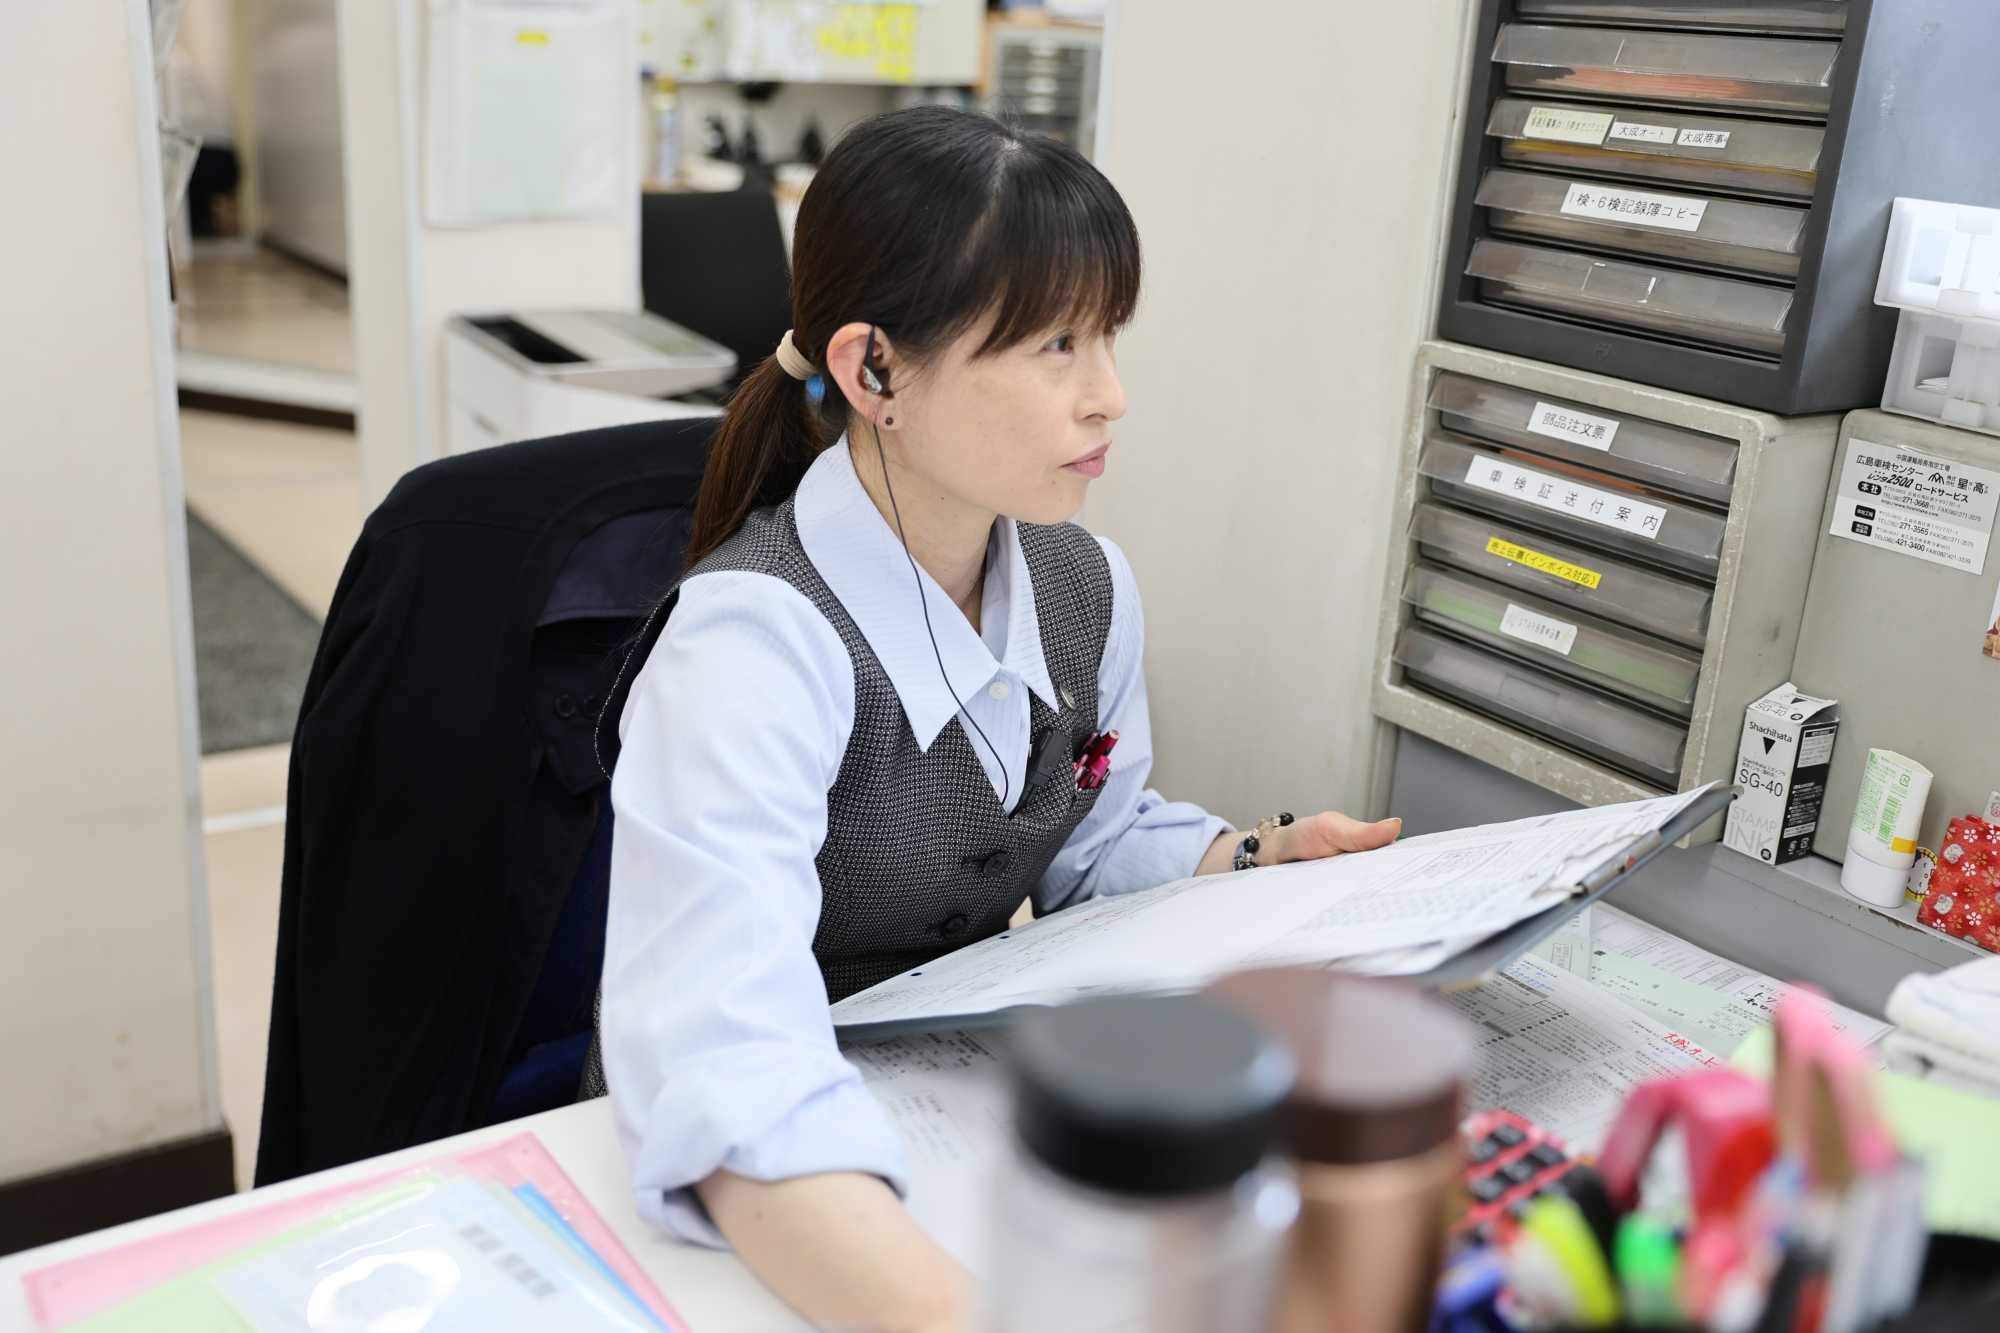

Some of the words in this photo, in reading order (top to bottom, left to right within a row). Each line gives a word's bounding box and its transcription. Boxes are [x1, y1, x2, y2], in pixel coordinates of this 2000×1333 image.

[1543, 411, 1607, 441] 部品注文票
[1856, 454, 1924, 477] 広島車検センター
[1914, 482, 1969, 504] ロードサービス
[1748, 720, 1793, 744] Shachihata
[1738, 768, 1784, 797] SG-40
[1732, 805, 1778, 833] STAMP
[1727, 820, 1775, 852] INK
